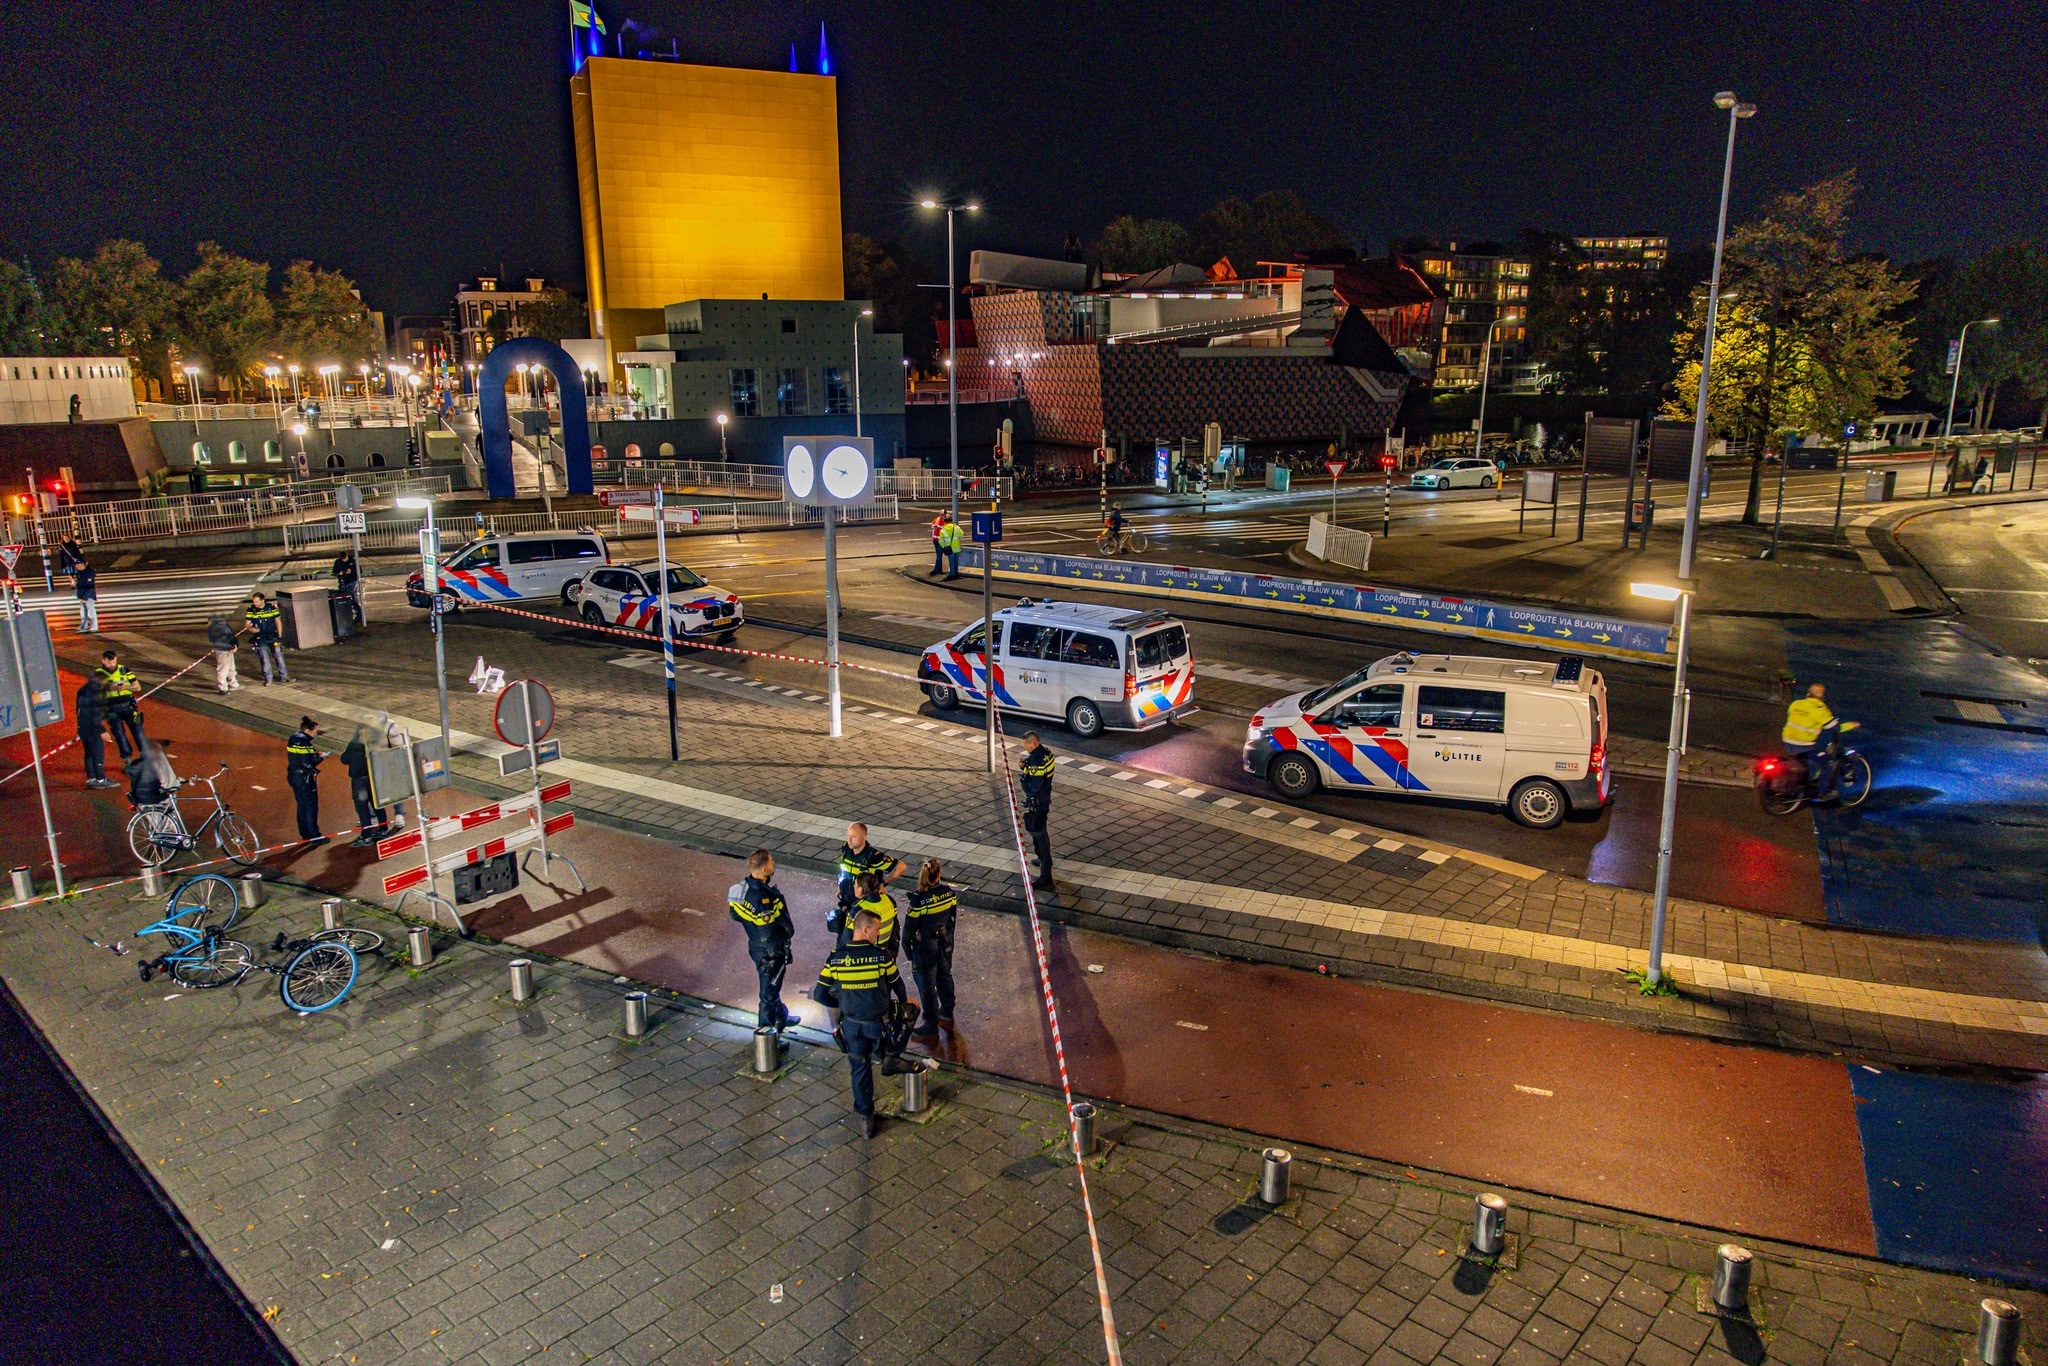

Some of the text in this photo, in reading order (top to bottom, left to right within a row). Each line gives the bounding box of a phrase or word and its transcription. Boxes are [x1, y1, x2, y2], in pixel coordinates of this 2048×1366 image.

[1846, 426, 1855, 434] C
[341, 514, 363, 523] TAXI'S
[976, 520, 985, 535] L
[992, 520, 999, 535] L
[1065, 561, 1094, 569] LOOPROUTE
[1104, 564, 1121, 572] BLAUW
[1155, 569, 1189, 579] LOOPROUTE
[1199, 573, 1219, 581] BLAUW
[1220, 575, 1232, 583] VAK
[1258, 579, 1345, 596] LOOPROUTE VIA BLAUW VAK
[1375, 594, 1474, 613] LOOPROUTE VIA BLAUW VAK
[1509, 611, 1624, 633] LOOPROUTE VIA BLAUW VAK
[1018, 673, 1048, 684] POLITIE
[1434, 750, 1482, 762] POLITIE
[840, 957, 873, 967] POLITIE
